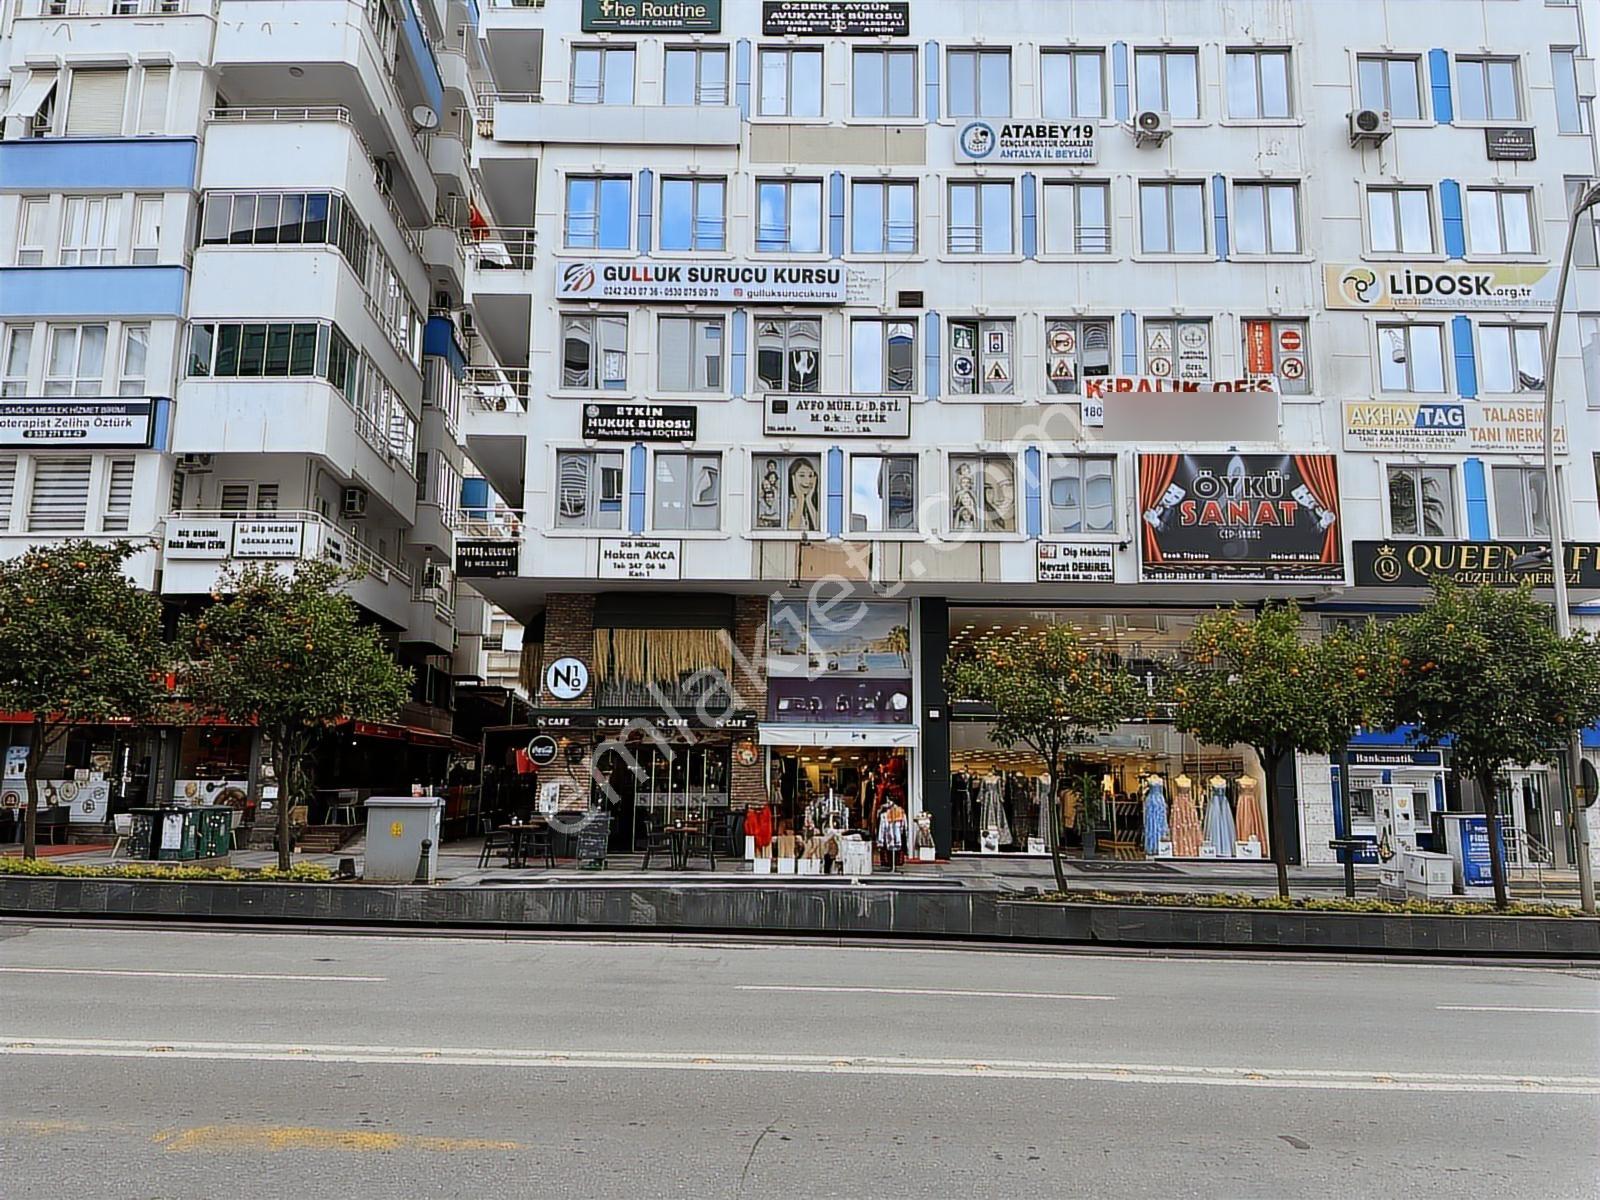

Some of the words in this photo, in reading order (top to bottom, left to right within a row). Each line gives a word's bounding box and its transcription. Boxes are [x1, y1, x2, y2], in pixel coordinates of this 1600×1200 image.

[642, 2, 706, 17] Routine
[848, 11, 902, 20] BÜROSU
[1000, 125, 1093, 138] ATABEY19
[1000, 149, 1040, 158] ANTALYA
[1044, 148, 1053, 158] İL
[774, 268, 840, 284] KURSU
[747, 288, 838, 298] gulluksurucukursu
[796, 400, 824, 411] AYFO
[54, 418, 90, 428] Zeliha
[93, 416, 132, 428] Öztürk
[588, 418, 635, 428] HUKUK
[638, 417, 691, 429] BÜROSU
[855, 412, 887, 424] ÇELİK
[1420, 408, 1464, 426] TAG
[1470, 427, 1500, 442] TANI
[1506, 425, 1566, 443] MERKZİ
[1193, 470, 1284, 499] ÖYKÜ
[1181, 500, 1298, 527] SANAT
[604, 550, 640, 560] Hakan
[1063, 547, 1078, 558] Diş
[1080, 547, 1111, 557] Hekimi
[548, 718, 570, 726] CAFE
[608, 718, 629, 726] CAFE
[667, 719, 688, 727] CAFE
[1356, 753, 1414, 763] Bankamatik
